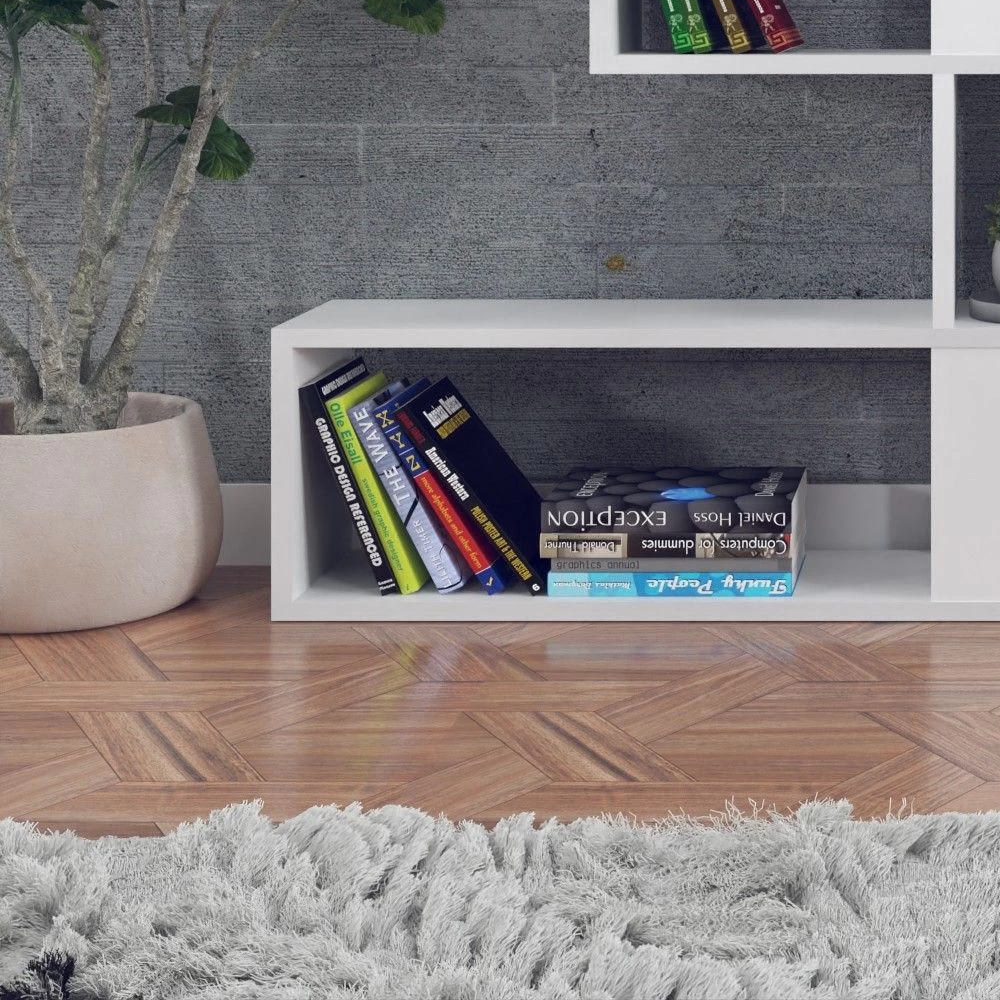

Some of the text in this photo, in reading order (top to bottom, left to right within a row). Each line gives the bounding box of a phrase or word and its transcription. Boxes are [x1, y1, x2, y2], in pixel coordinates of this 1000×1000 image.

[330, 402, 346, 428] Olle
[376, 410, 395, 428] X
[353, 407, 388, 463] WAVE
[390, 432, 406, 449] Y
[406, 454, 421, 472] Z
[424, 446, 452, 481] American
[447, 472, 470, 502] Western
[315, 417, 383, 568] GRAPHIC DESIGN REFERENCED
[362, 478, 378, 509] swedish
[382, 465, 412, 506] THE
[420, 476, 434, 495] more
[430, 491, 453, 524] alphabets
[544, 541, 616, 552] Donald Thurner
[642, 537, 786, 555] Computers for dummies
[556, 559, 640, 570] graphics annual
[646, 574, 786, 595] Funky People
